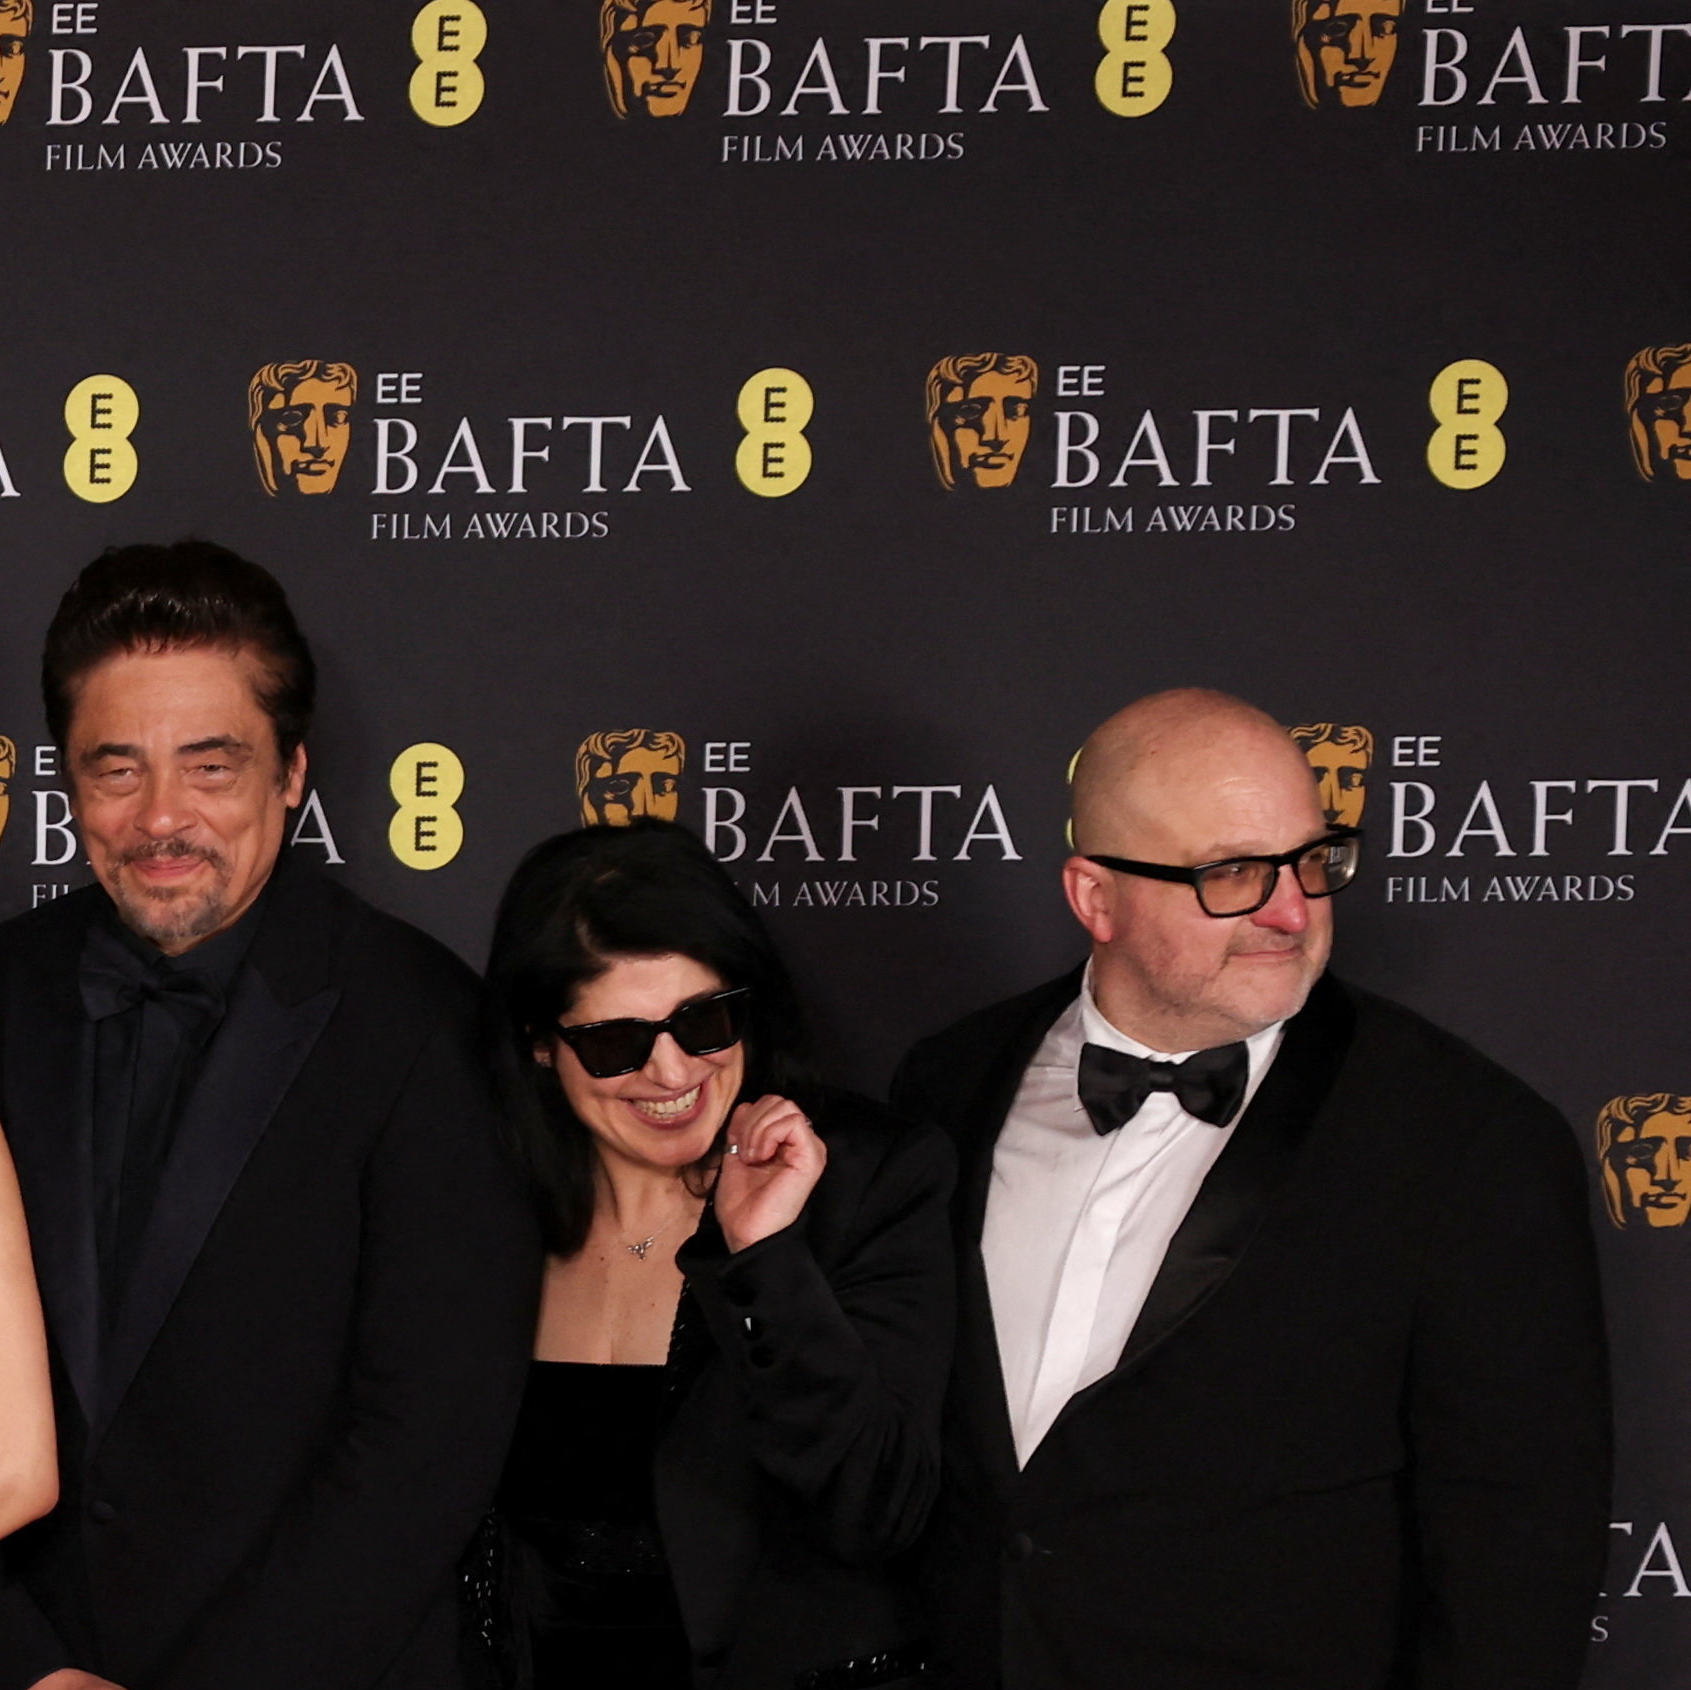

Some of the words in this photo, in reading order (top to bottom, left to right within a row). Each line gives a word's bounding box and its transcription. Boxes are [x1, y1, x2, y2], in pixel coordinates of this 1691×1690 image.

[51, 2, 99, 35] EE
[730, 0, 778, 24] EE
[722, 33, 1050, 117] BAFTA
[1417, 23, 1691, 106] BAFT
[45, 43, 365, 126] BAFTA
[722, 135, 803, 163] FILM
[816, 133, 964, 161] AWARDS
[1417, 125, 1500, 152] FILM
[1514, 122, 1666, 150] AWARDS
[46, 143, 125, 171] FILM
[137, 141, 282, 170] AWARDS
[376, 372, 424, 404] EE
[1056, 365, 1106, 397] EE
[371, 414, 692, 495] BAFTA
[1050, 406, 1382, 488] BAFTA
[371, 513, 451, 540] FILM
[463, 511, 609, 539] AWARDS
[1050, 506, 1133, 533] FILM
[1145, 504, 1296, 532] AWARDS
[34, 745, 57, 776] E
[704, 742, 751, 773] EE
[1392, 735, 1442, 767] EE
[701, 784, 1024, 862] BAFTA
[794, 880, 939, 906] AWARDS
[1387, 876, 1470, 903] FILM
[1482, 875, 1635, 902] AWARDS
